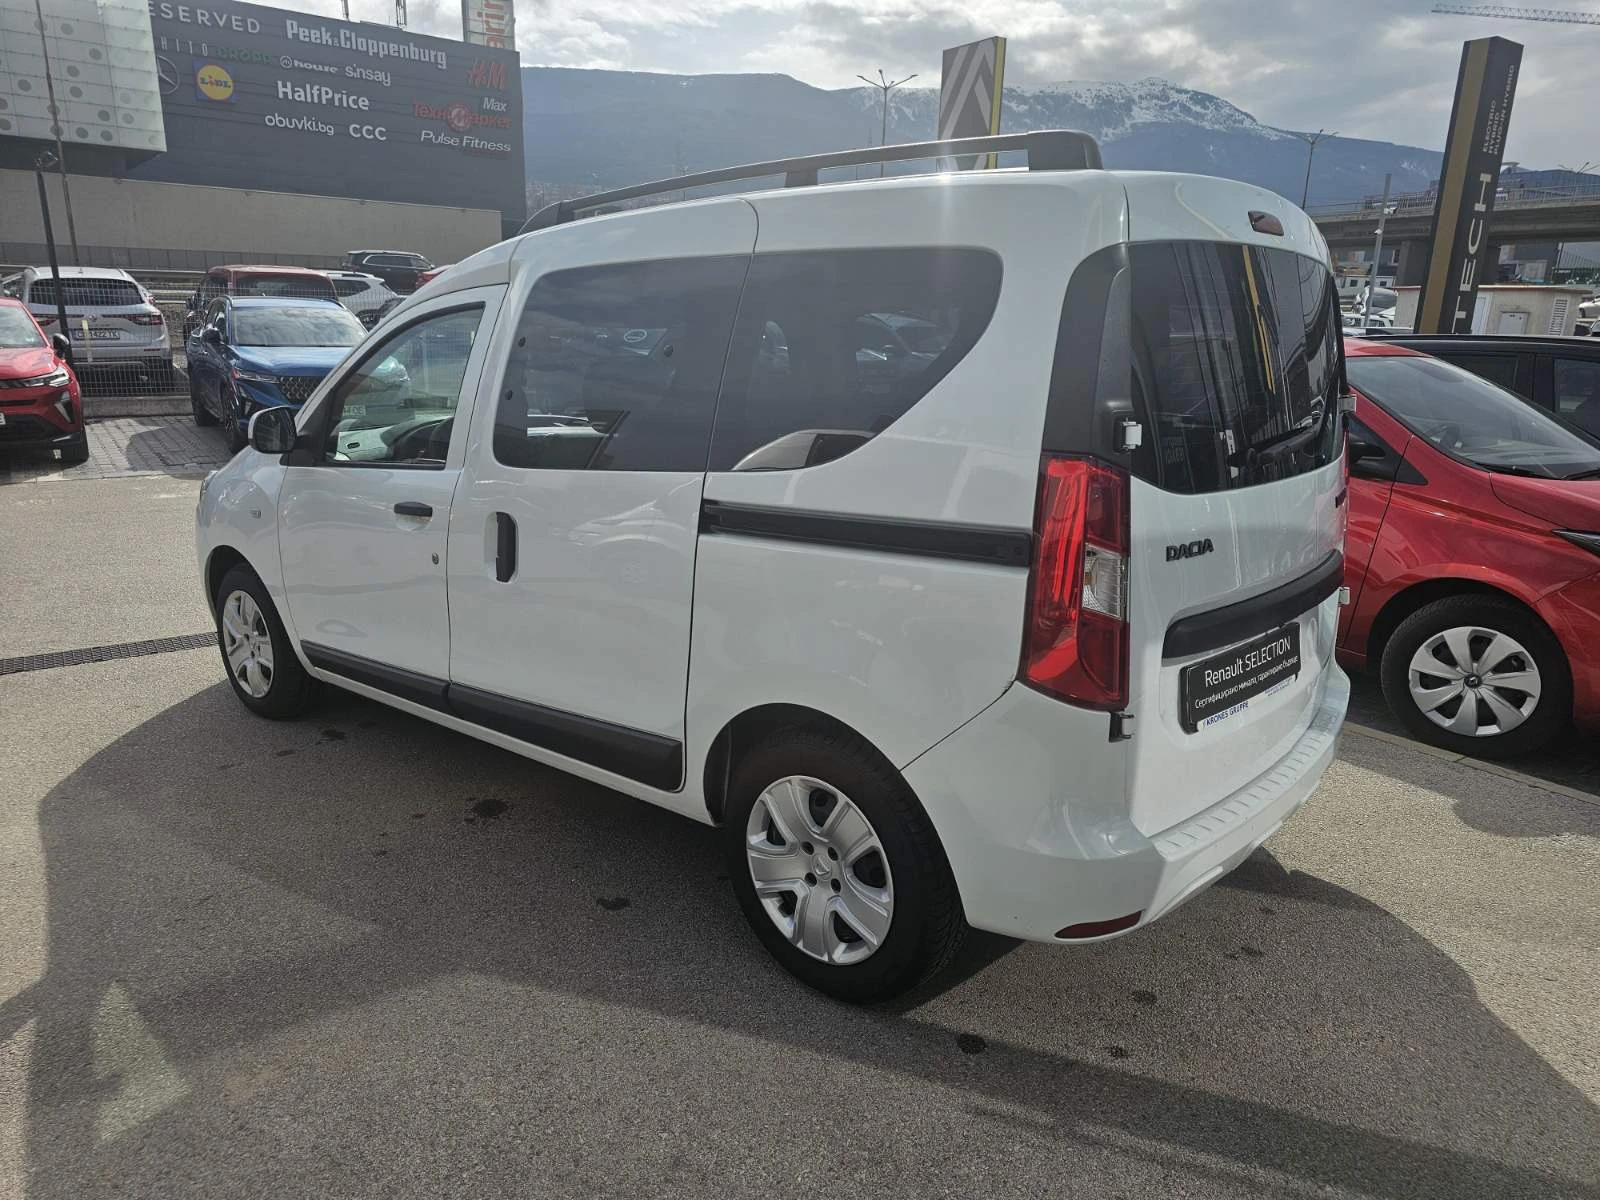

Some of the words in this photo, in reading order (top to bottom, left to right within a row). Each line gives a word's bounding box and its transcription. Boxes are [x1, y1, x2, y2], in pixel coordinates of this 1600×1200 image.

[277, 80, 369, 110] HalfPrice
[483, 97, 507, 112] Max
[265, 113, 334, 136] obuvki.bg
[421, 130, 459, 146] Pulse
[462, 136, 511, 152] Fitness
[1166, 538, 1214, 562] DACIA
[1204, 658, 1244, 688] Renault
[1245, 635, 1291, 671] SELECTION
